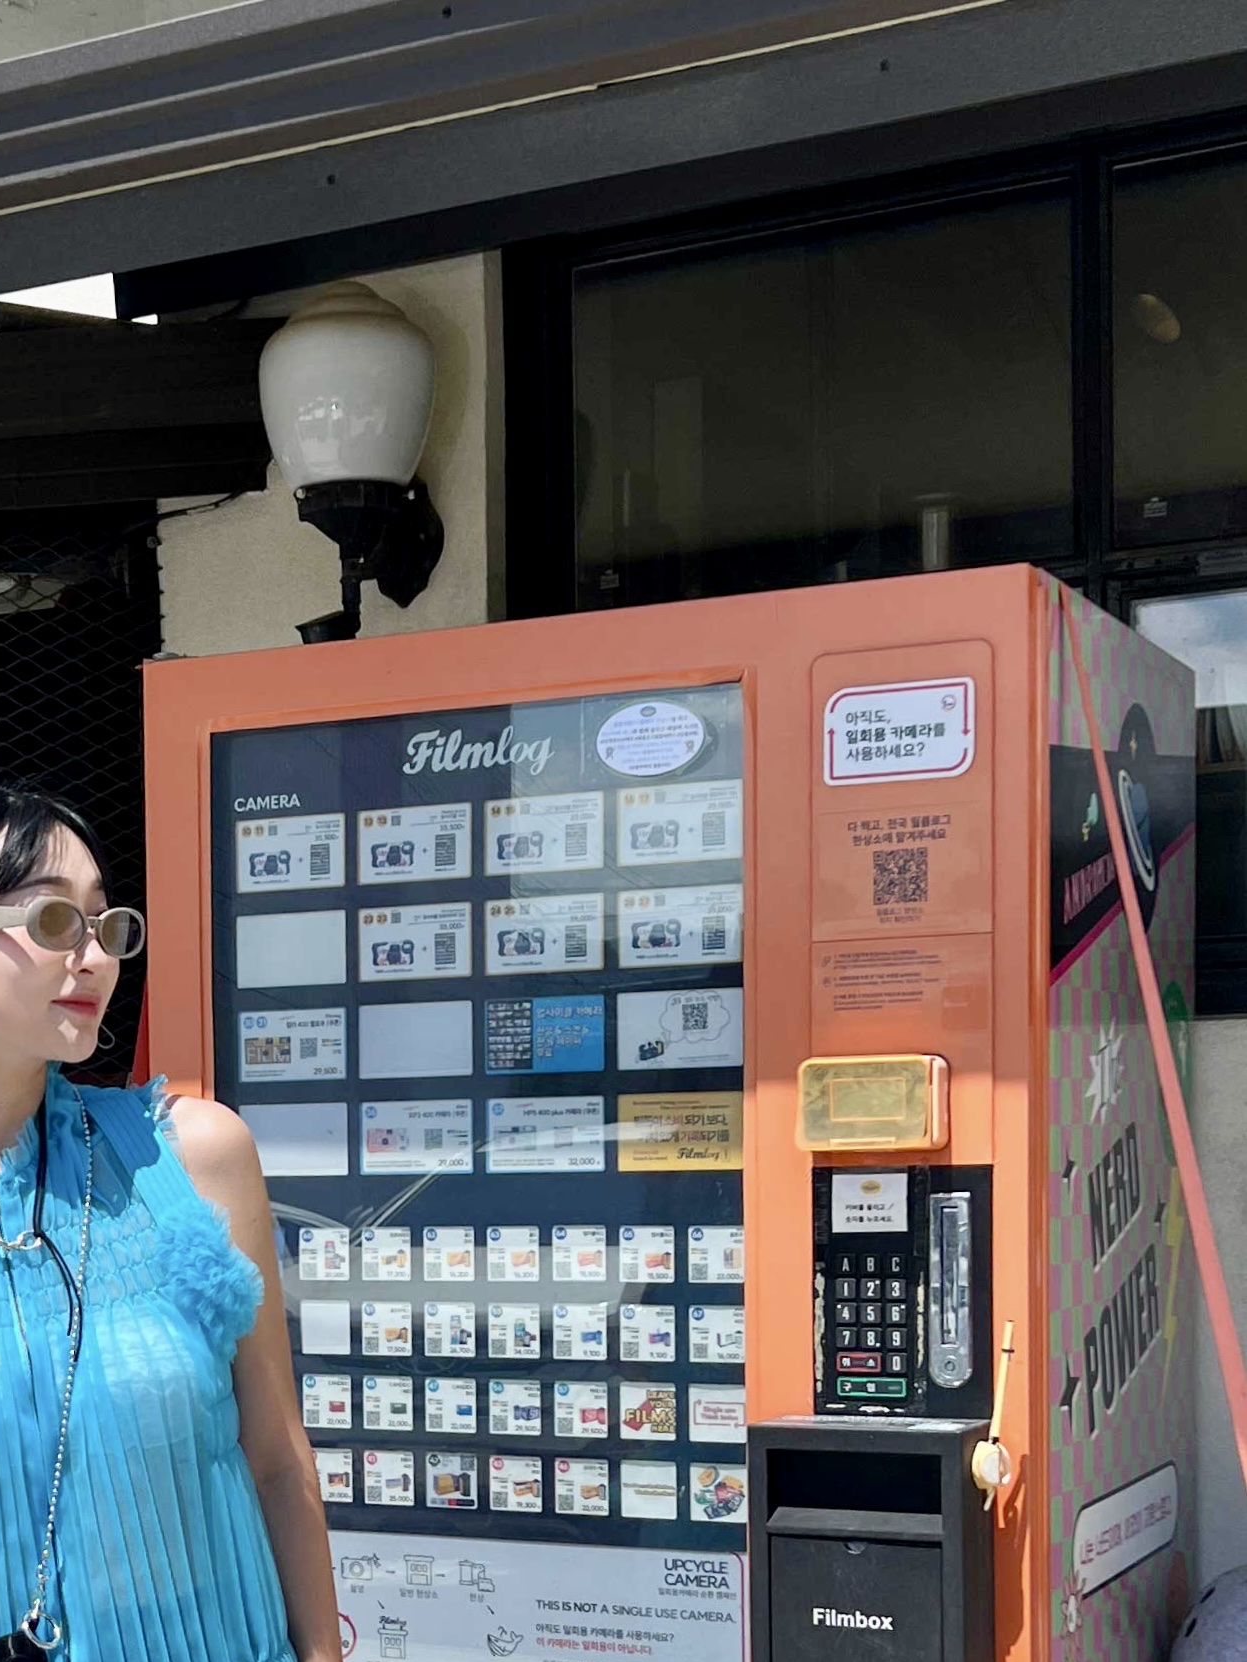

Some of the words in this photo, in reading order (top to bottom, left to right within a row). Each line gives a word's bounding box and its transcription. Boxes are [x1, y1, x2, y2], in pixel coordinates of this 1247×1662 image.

[846, 708, 891, 726] 아직도,
[846, 728, 886, 744] 일회용
[890, 722, 945, 741] 카메라를
[402, 725, 555, 775] Filmlog
[846, 742, 925, 762] 사용하세요?
[234, 793, 300, 812] CAMERA
[1088, 1121, 1142, 1271] NERD
[842, 1257, 850, 1272] A
[866, 1257, 875, 1272] B
[892, 1257, 900, 1272] C
[842, 1282, 850, 1297] 1
[866, 1282, 875, 1297] 2
[892, 1282, 900, 1297] 3
[842, 1306, 850, 1320] 4
[866, 1306, 875, 1320] 5
[892, 1306, 900, 1320] 6
[842, 1330, 850, 1345] 7
[866, 1330, 875, 1345] 8
[892, 1330, 900, 1345] 9
[1083, 1243, 1160, 1438] POWER
[892, 1355, 901, 1371] 0
[626, 1410, 675, 1423] FILMS
[664, 1558, 729, 1574] UPCYCLE
[664, 1573, 730, 1589] CAMERA
[535, 1600, 560, 1611] THIS
[562, 1601, 572, 1611] IS
[574, 1602, 598, 1613] NOT
[600, 1604, 609, 1614] A
[613, 1605, 653, 1618] SINGLE
[655, 1609, 679, 1620] USE
[680, 1610, 737, 1624] CAMERA.
[812, 1607, 894, 1631] Filmbox
